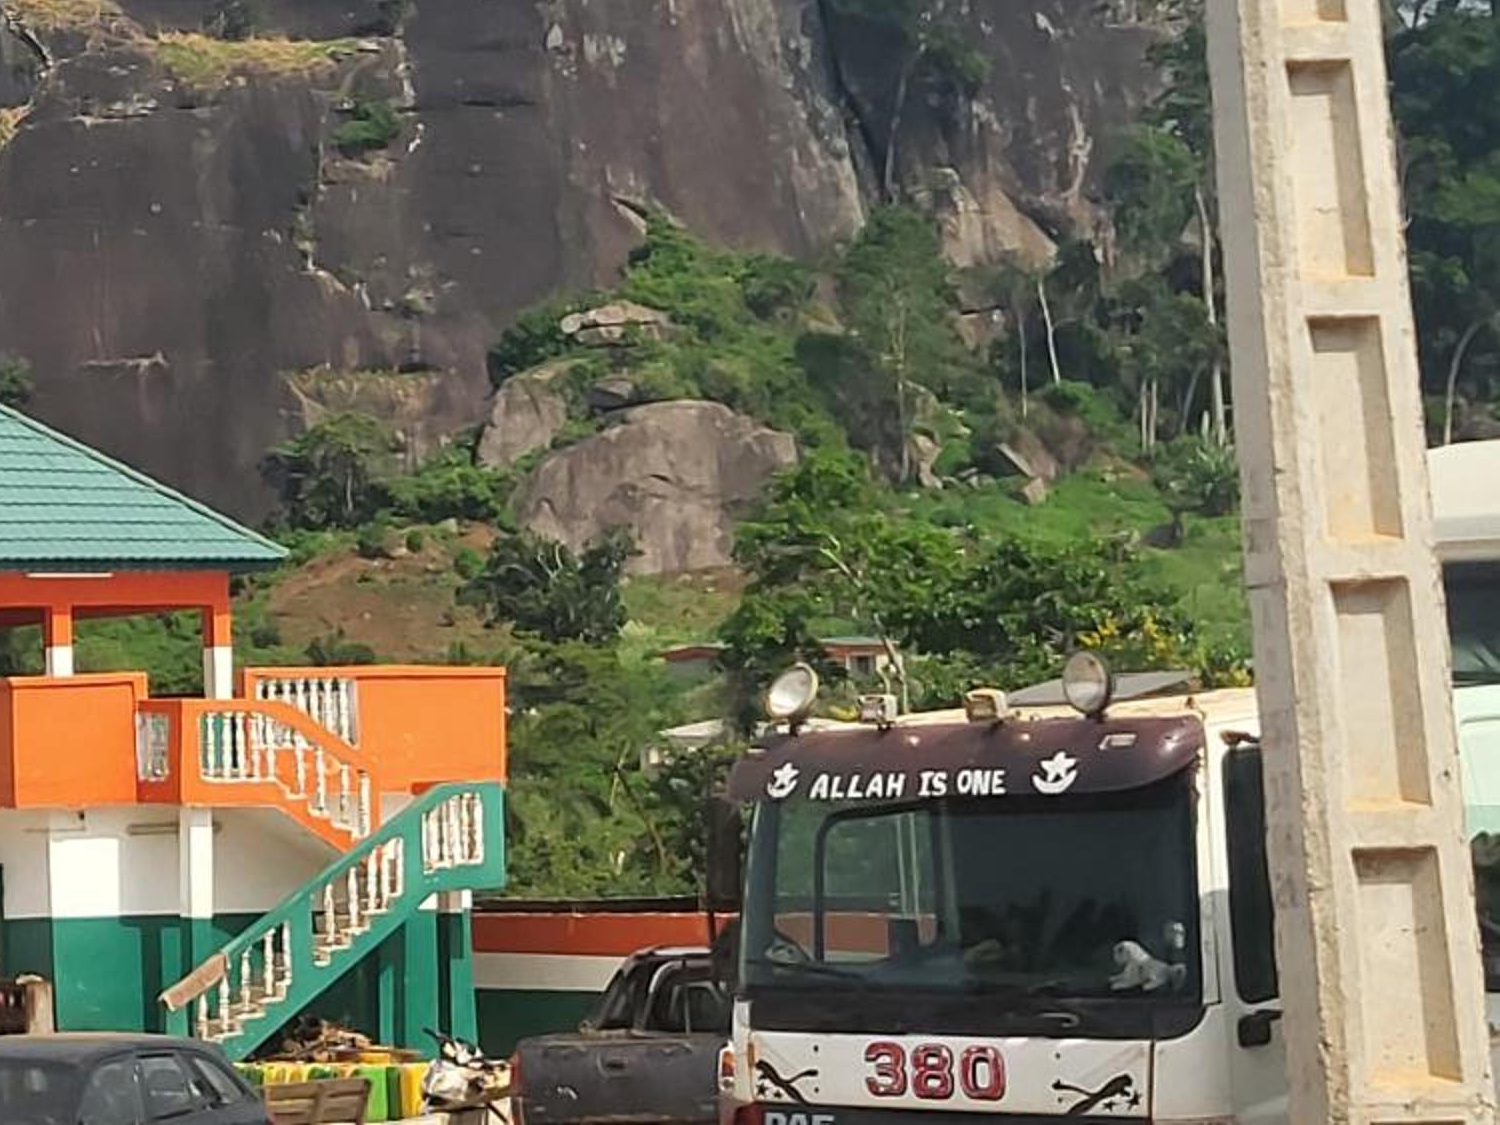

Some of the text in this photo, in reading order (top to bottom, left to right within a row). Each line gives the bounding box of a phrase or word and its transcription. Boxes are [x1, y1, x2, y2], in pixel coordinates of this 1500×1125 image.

[808, 768, 1007, 800] ALLAH IS ONE
[864, 1041, 1006, 1102] 380
